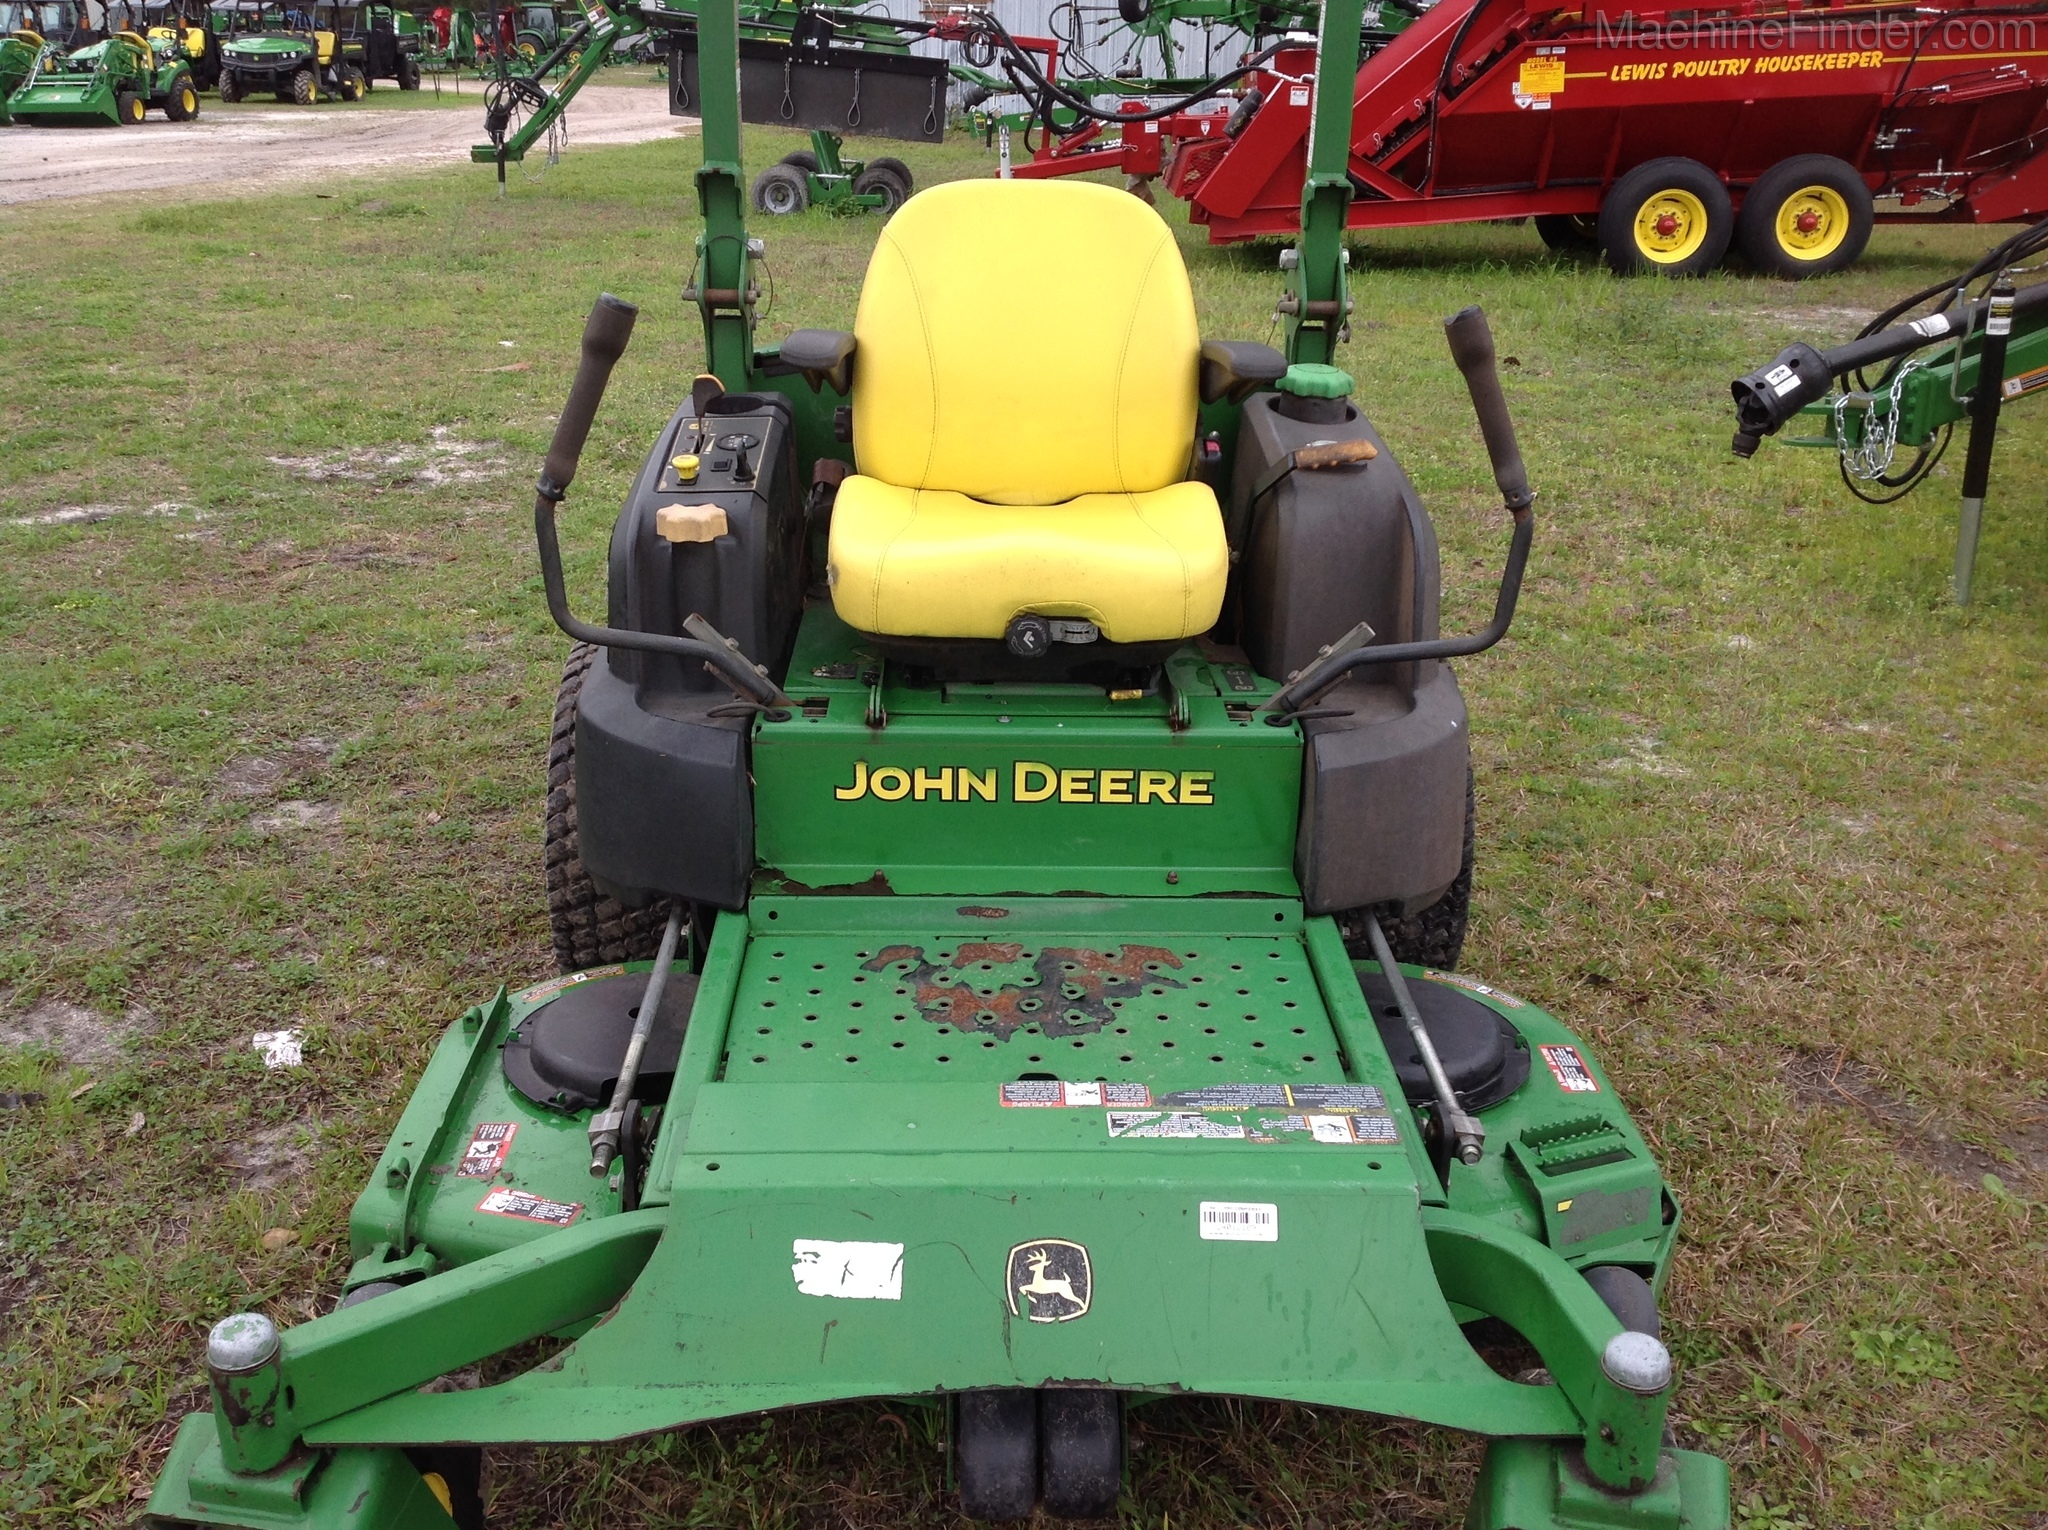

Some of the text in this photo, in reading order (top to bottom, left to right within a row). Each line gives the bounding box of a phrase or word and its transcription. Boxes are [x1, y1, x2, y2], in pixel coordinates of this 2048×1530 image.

[1610, 51, 1884, 81] LEWIS POULTRY HOUSEKEEPER
[834, 760, 1215, 806] JOHN DEERE
